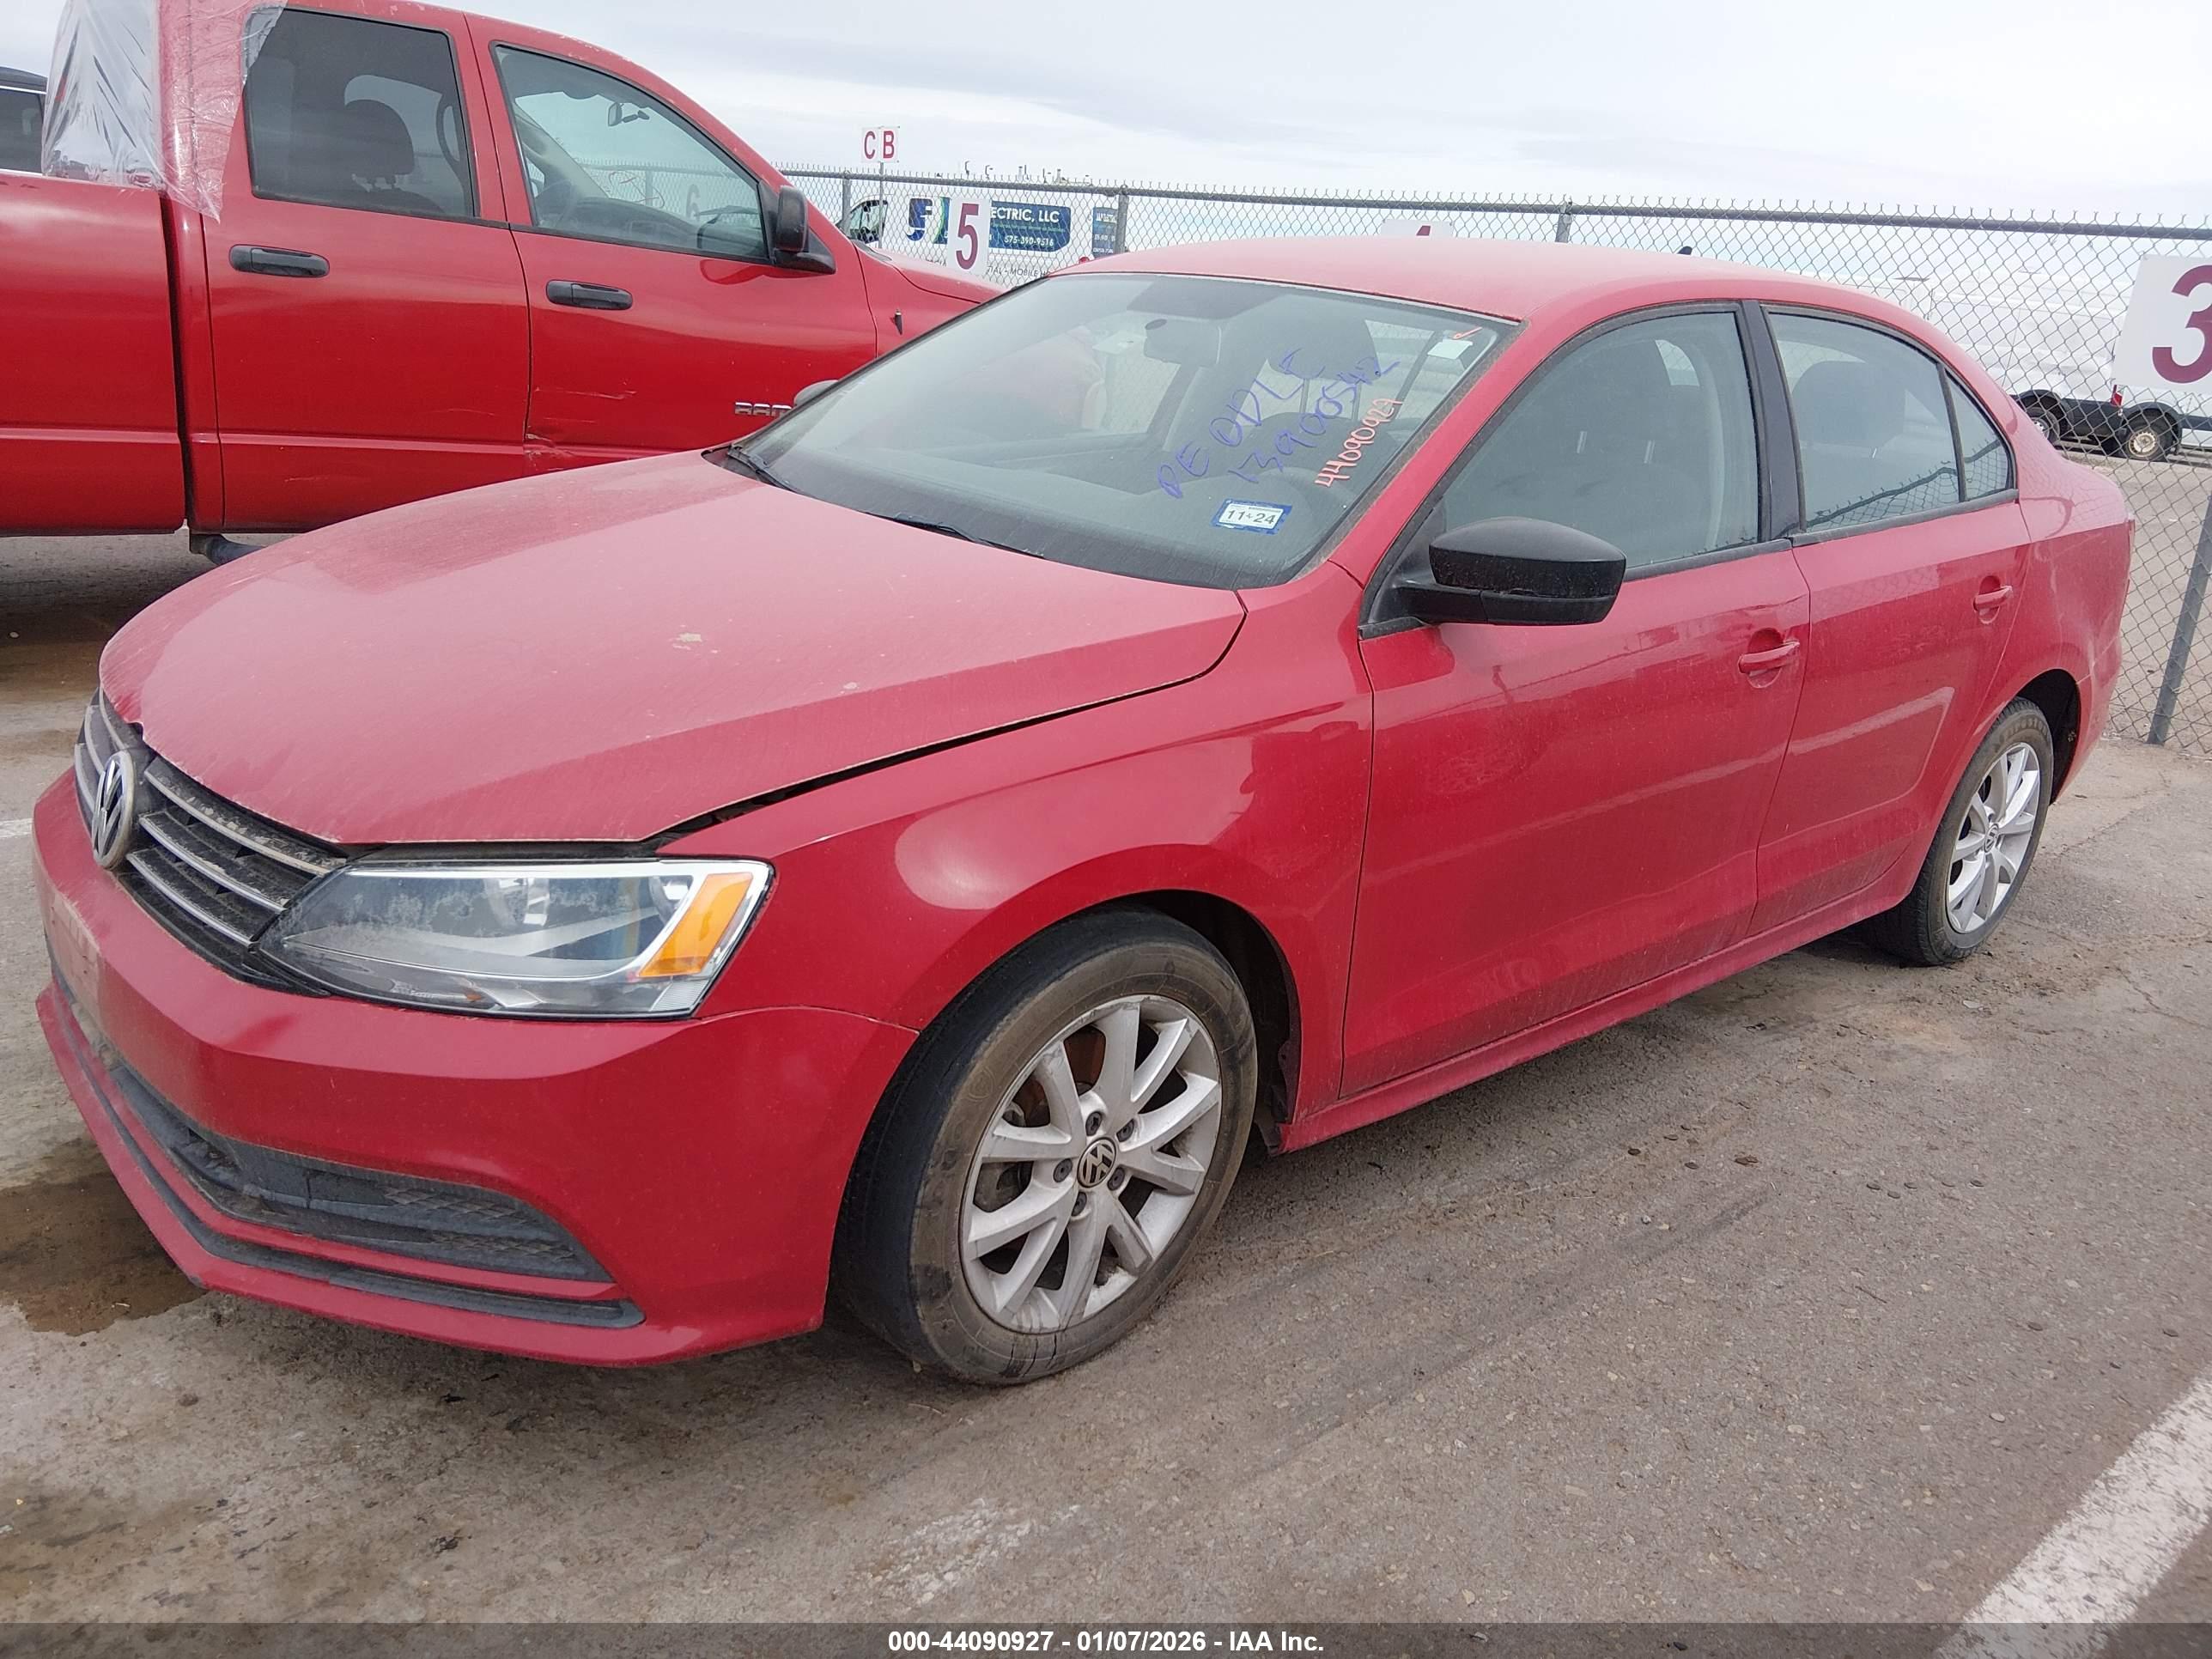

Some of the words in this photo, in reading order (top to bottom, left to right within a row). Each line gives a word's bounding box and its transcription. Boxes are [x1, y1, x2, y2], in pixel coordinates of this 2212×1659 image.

[956, 202, 980, 270] 5
[1038, 210, 1060, 223] LLC
[2152, 264, 2212, 384] 3
[1314, 398, 1403, 488] 44090927
